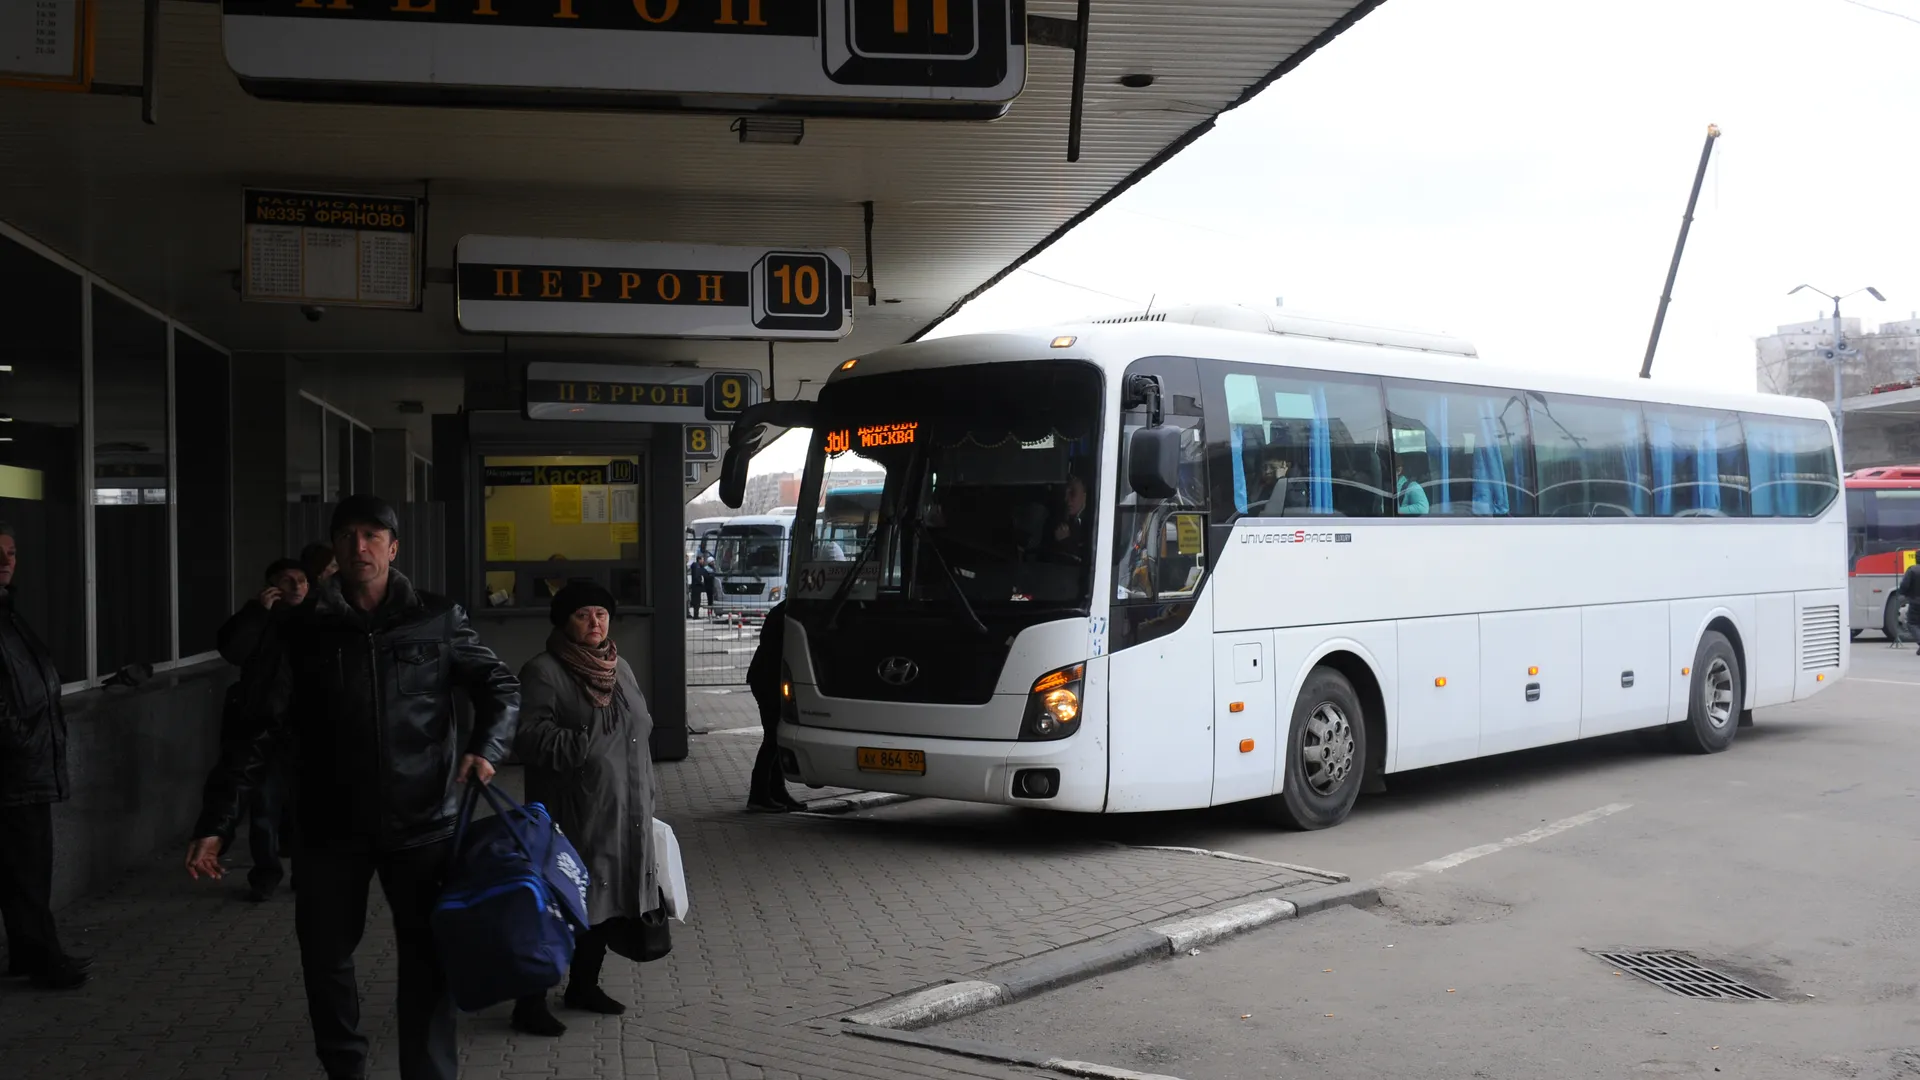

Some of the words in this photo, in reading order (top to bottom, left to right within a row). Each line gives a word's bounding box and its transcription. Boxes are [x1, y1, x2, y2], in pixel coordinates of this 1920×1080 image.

[257, 197, 405, 212] РАСПИСАНИЕ
[256, 205, 307, 222] №335
[314, 209, 405, 227] ФРЯНОВО
[493, 267, 725, 303] ПЕРРОН
[773, 263, 820, 306] 10
[557, 381, 691, 405] ПЕРРОН
[720, 378, 742, 409] 9
[690, 429, 707, 452] 8
[861, 429, 915, 448] МОСКВА
[534, 465, 603, 485] Касса
[880, 751, 902, 768] 864
[907, 752, 920, 765] 50
